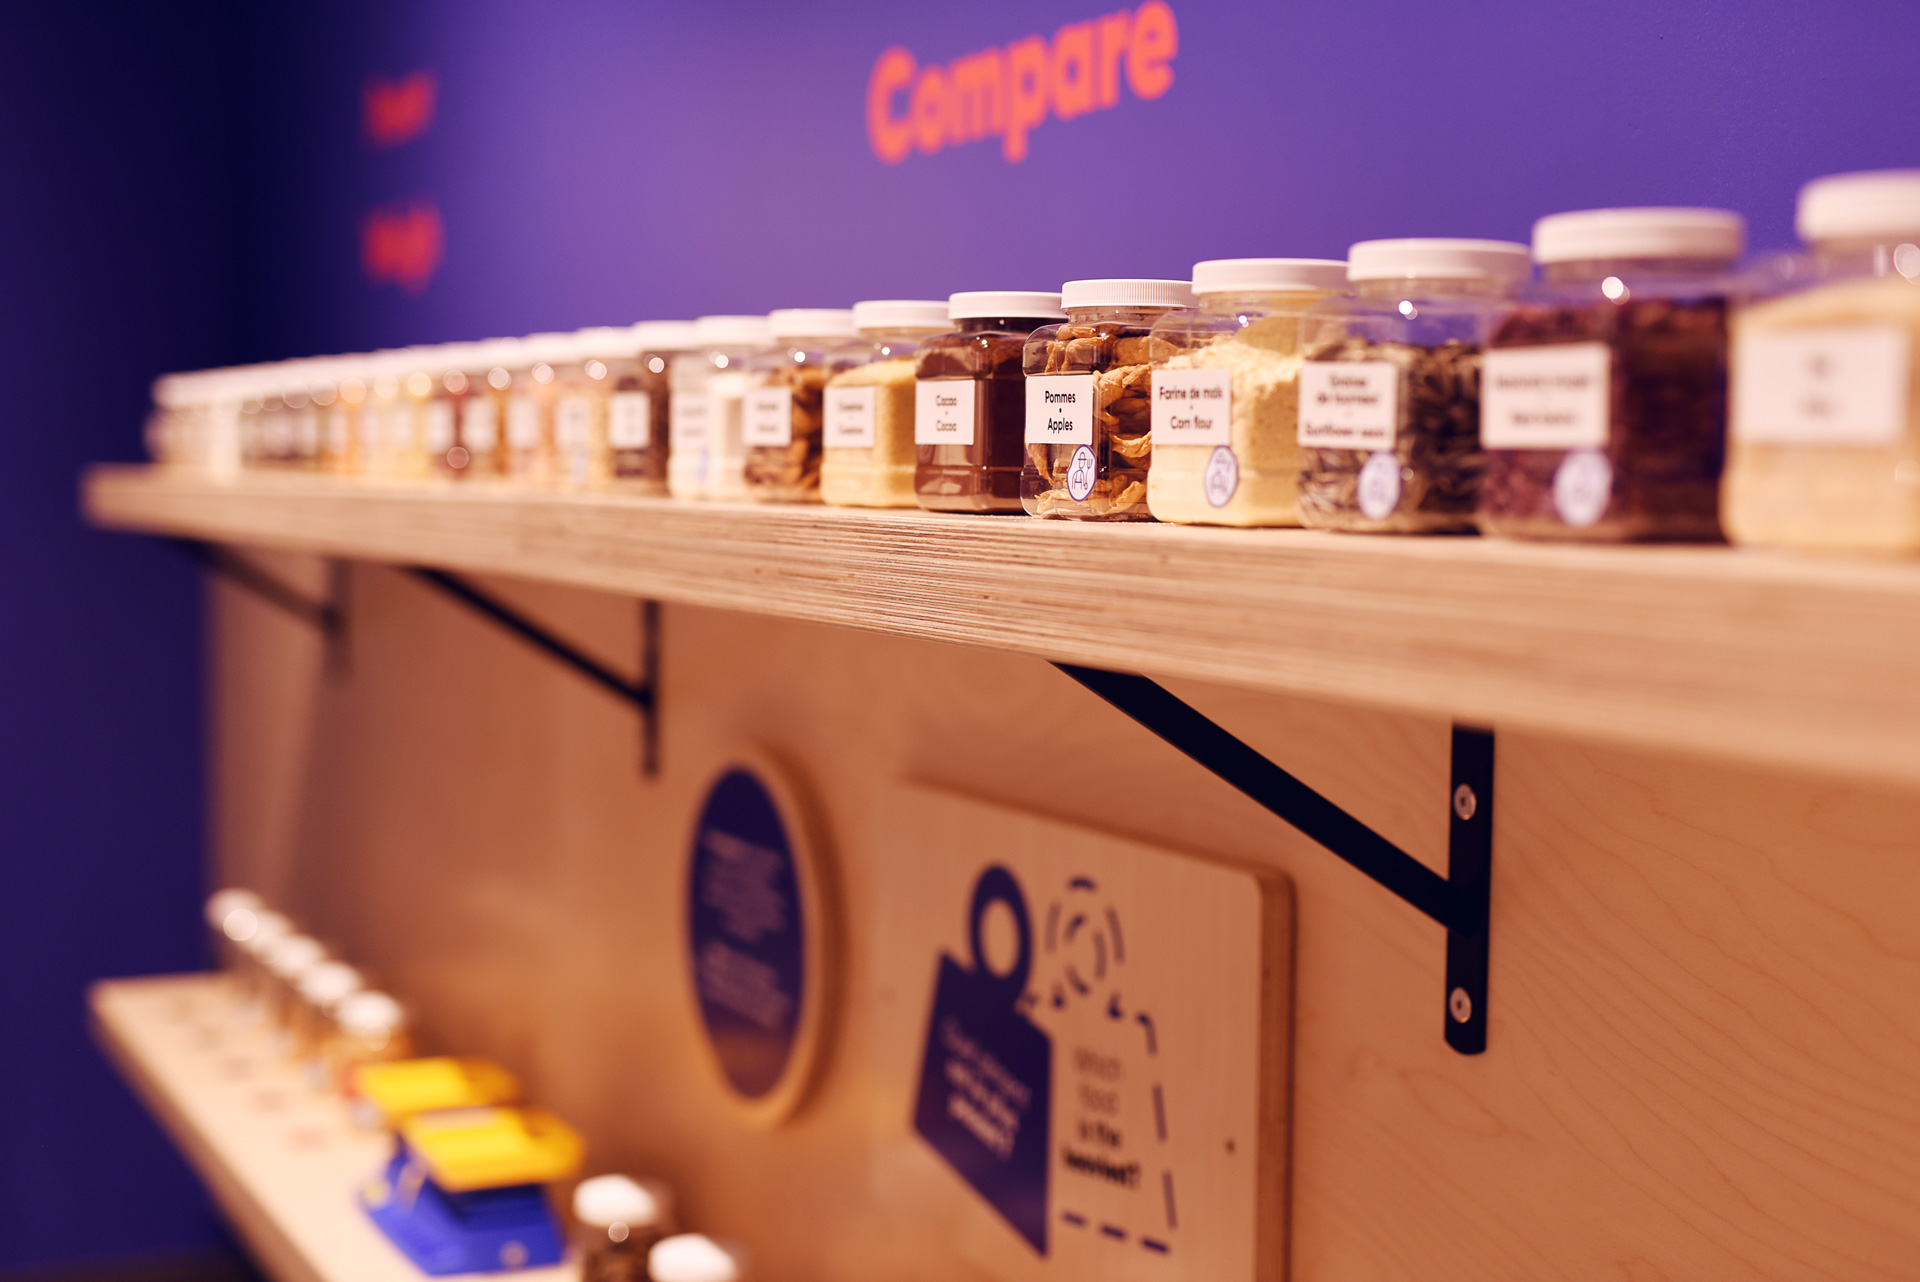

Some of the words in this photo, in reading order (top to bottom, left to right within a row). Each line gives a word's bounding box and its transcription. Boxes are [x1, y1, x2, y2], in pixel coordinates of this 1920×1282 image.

[867, 1, 1178, 163] Compare
[1045, 390, 1076, 404] Pommes
[1159, 386, 1186, 400] Farine
[1190, 386, 1200, 400] de
[1047, 417, 1073, 434] Apples
[1170, 416, 1190, 429] Corn
